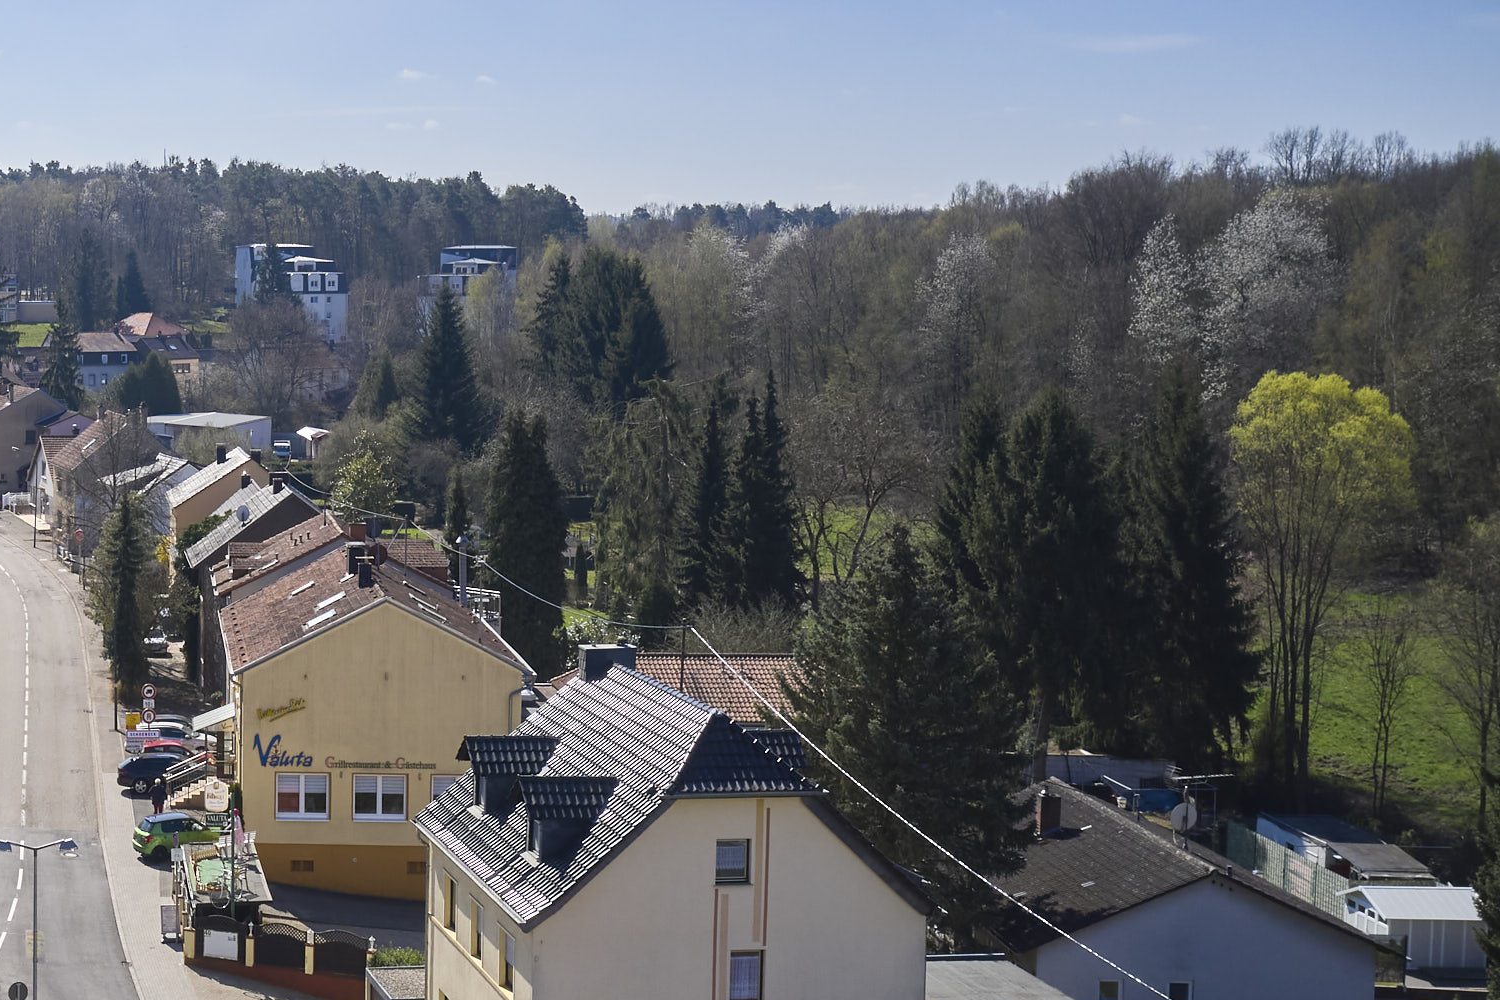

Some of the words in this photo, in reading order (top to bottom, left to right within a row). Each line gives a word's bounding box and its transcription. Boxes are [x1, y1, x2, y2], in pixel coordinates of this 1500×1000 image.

[252, 733, 313, 767] Valuta
[324, 755, 381, 769] Grillrestaurant
[395, 757, 436, 770] Gästehaus
